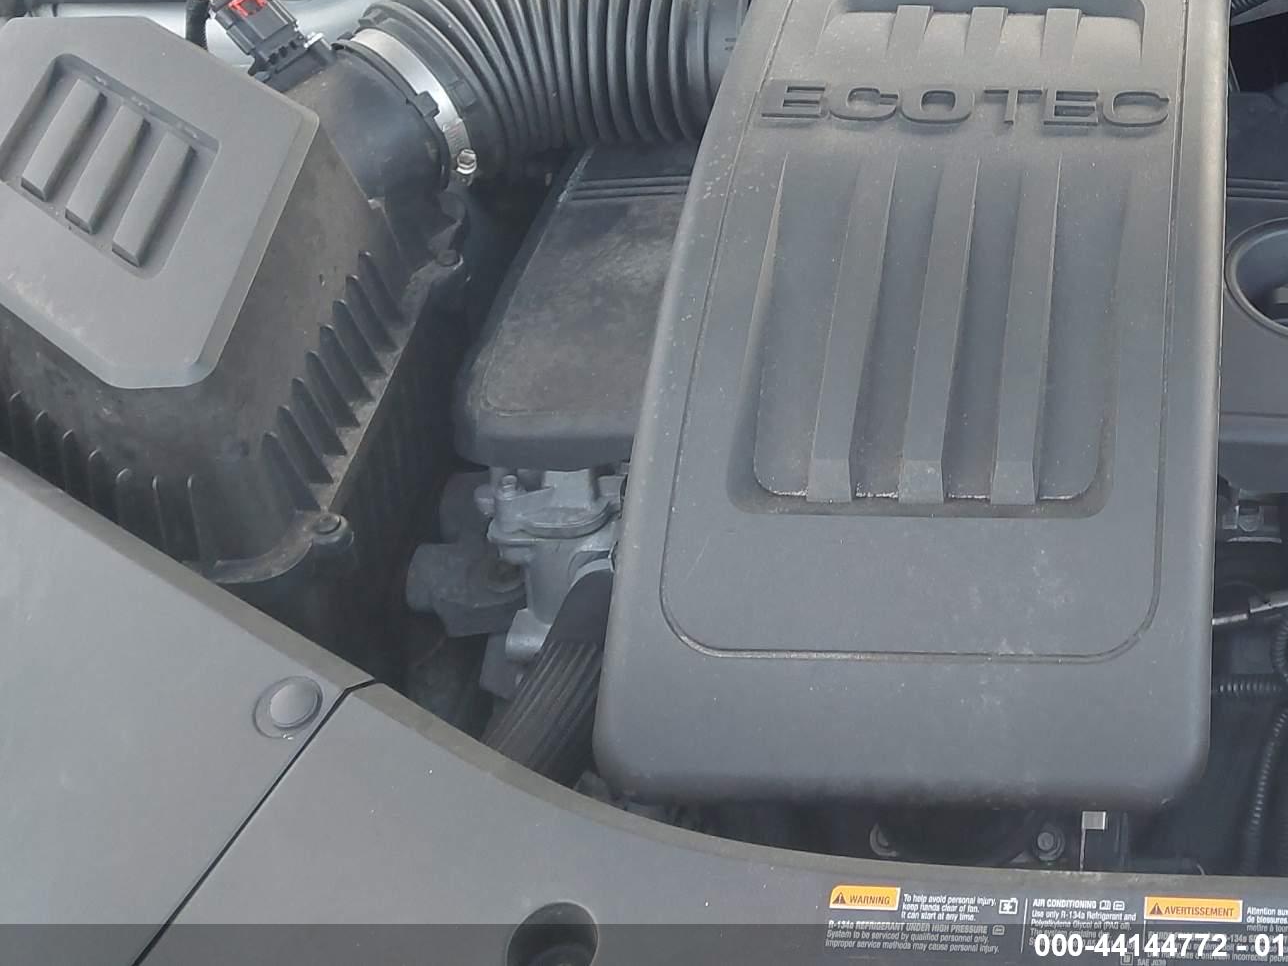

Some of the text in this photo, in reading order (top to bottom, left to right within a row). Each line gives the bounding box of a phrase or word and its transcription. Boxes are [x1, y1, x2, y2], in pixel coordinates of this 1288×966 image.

[761, 79, 1170, 127] ECOTEC
[849, 895, 890, 905] WARNING
[904, 894, 911, 902] To
[913, 895, 927, 905] help
[929, 895, 946, 903] avoid
[947, 896, 975, 905] personal
[1033, 899, 1097, 909] AIR CONDITIONING
[903, 902, 979, 913] keep hands clear of fan.
[1165, 906, 1234, 917] AVERTISSEMENT
[1247, 907, 1275, 915] Attention
[1277, 908, 1288, 916] aux
[921, 912, 936, 920] start
[937, 912, 945, 920] at
[946, 913, 958, 922] any
[959, 913, 976, 921] time.
[1031, 910, 1136, 921] Use only R-134a Refrigerant and
[1247, 915, 1254, 923] de
[1257, 916, 1288, 924] blessures.
[828, 920, 988, 934] R-134a REFRIGERANT UNDER HIGH PRESSURE
[1073, 920, 1092, 929] Glycol
[1247, 924, 1267, 932] mettre
[827, 930, 851, 939] System
[861, 931, 870, 939] be
[871, 932, 899, 940] serviced
[901, 932, 909, 941] by
[911, 933, 938, 942] qualified
[940, 934, 973, 943] personnel
[825, 939, 855, 949] Improper
[856, 940, 881, 949] service
[882, 941, 911, 950] methods
[912, 942, 927, 951] may
[928, 943, 948, 951] cause
[950, 943, 978, 952] personal
